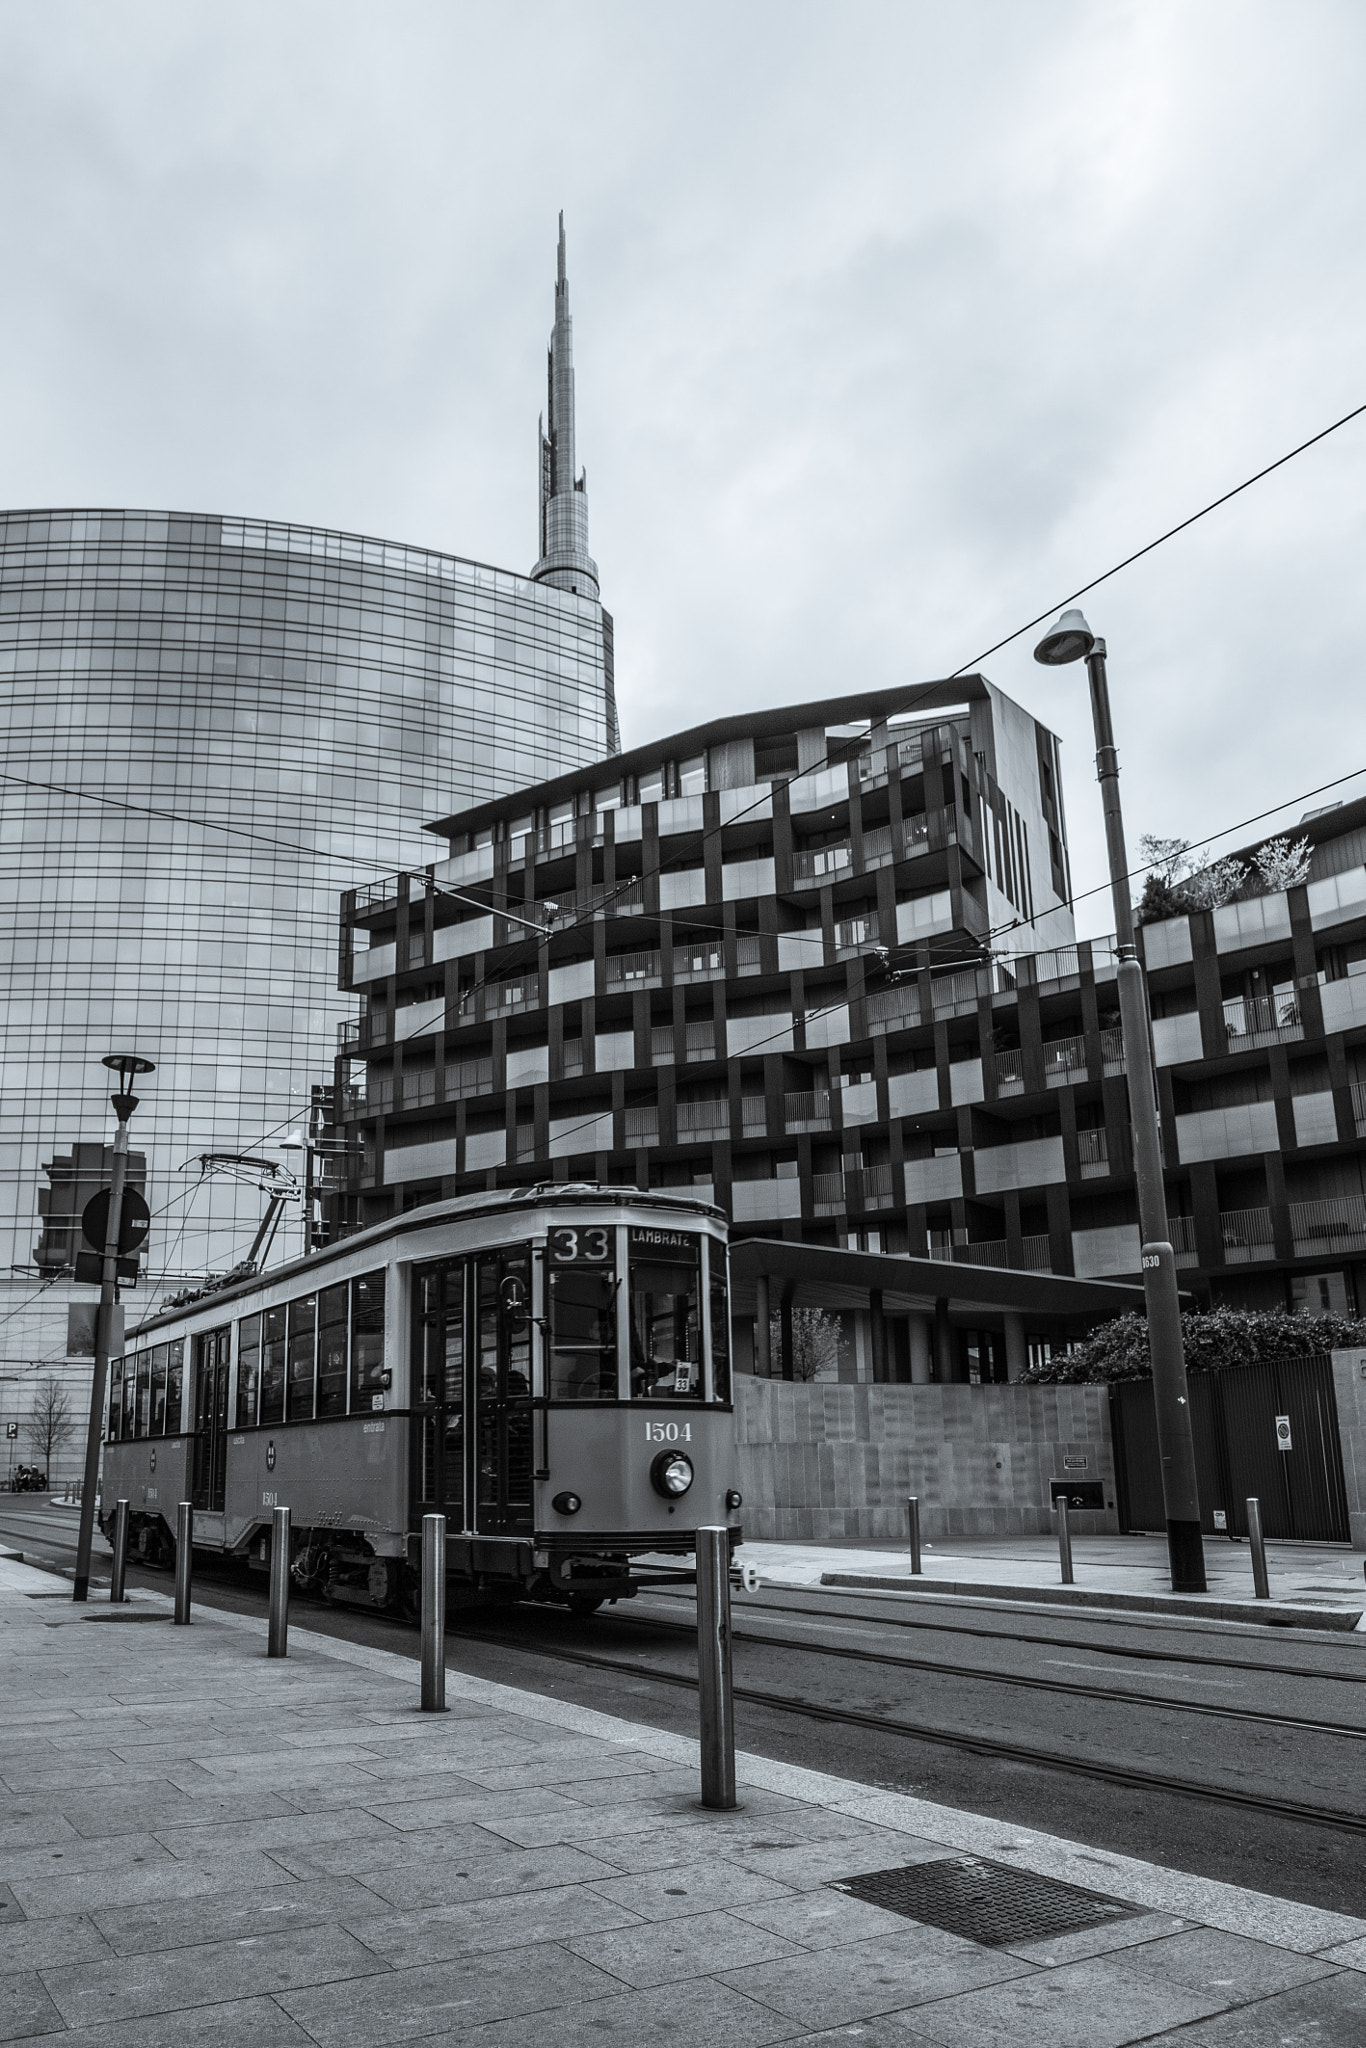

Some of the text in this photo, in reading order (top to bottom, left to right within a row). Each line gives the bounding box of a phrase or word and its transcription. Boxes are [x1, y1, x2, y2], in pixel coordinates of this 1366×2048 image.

[554, 1228, 608, 1261] 33
[632, 1228, 690, 1246] LAMBRATE
[677, 1379, 687, 1390] 33
[9, 1423, 16, 1433] P
[645, 1422, 693, 1442] 1504
